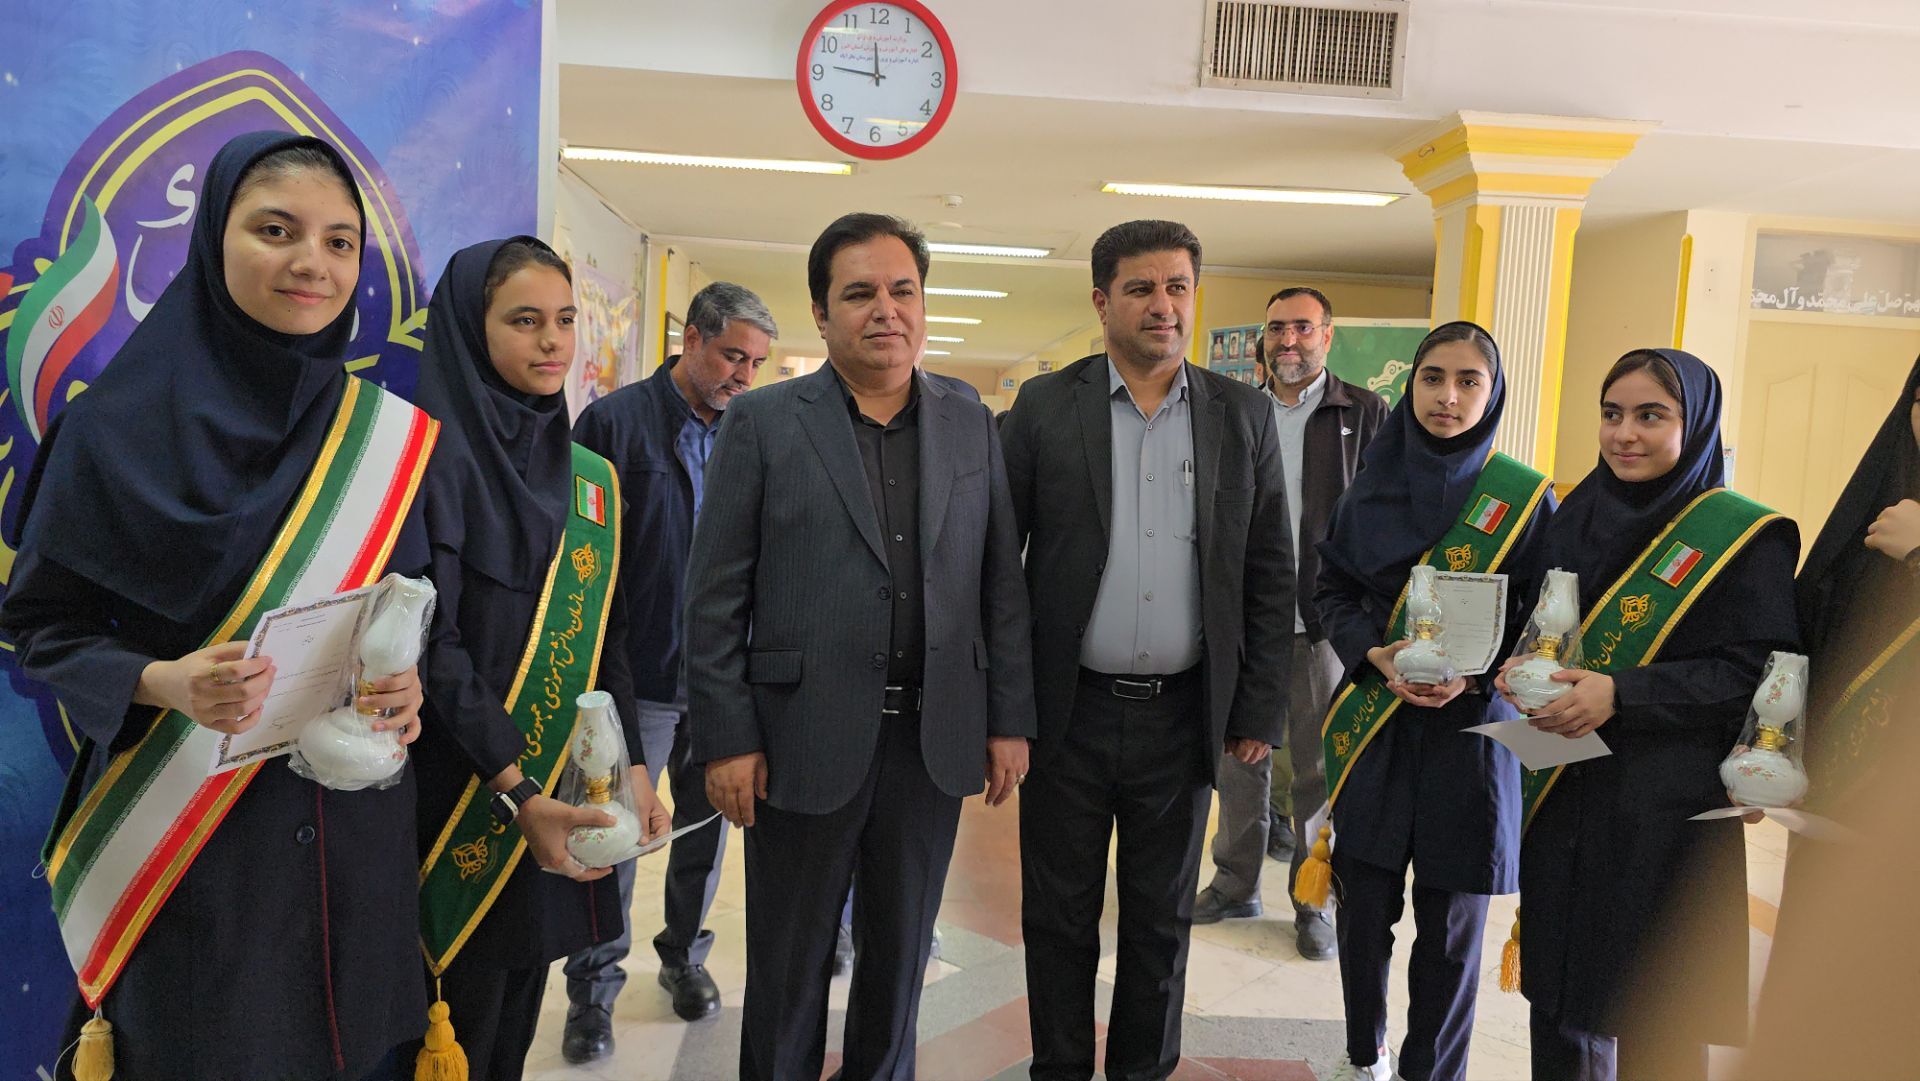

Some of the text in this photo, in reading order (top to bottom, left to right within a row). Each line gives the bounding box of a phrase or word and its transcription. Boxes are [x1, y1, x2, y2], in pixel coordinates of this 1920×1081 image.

[843, 14, 857, 29] 11
[870, 8, 890, 24] 12
[904, 17, 911, 34] 1
[821, 35, 837, 54] 10
[921, 41, 933, 58] 2
[812, 63, 824, 80] 9
[930, 71, 942, 88] 3
[821, 93, 833, 111] 8
[919, 99, 932, 116] 4
[842, 116, 854, 134] 7
[897, 121, 908, 137] 5
[869, 126, 881, 143] 6
[1795, 296, 1805, 311] و
